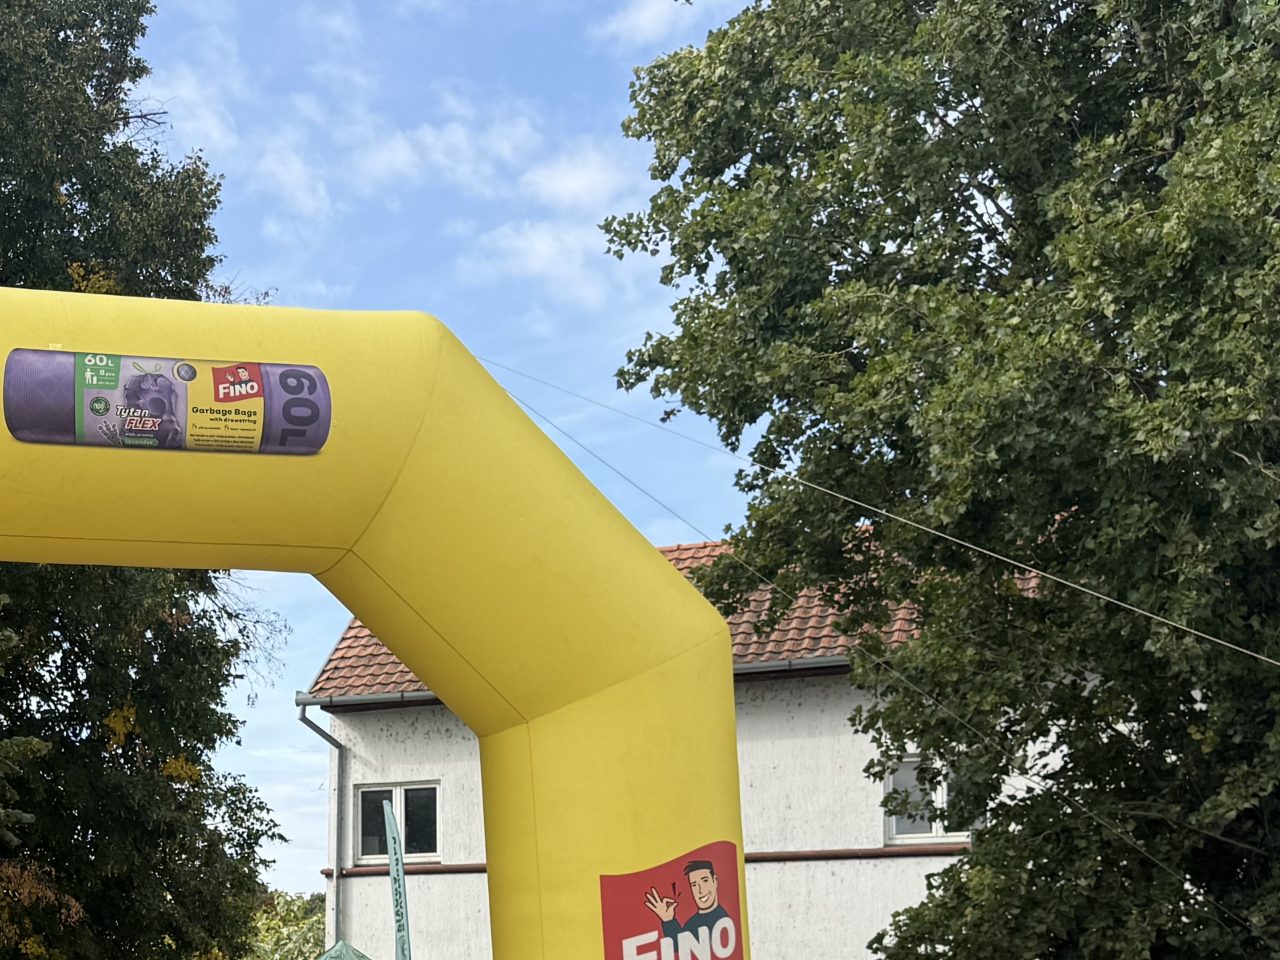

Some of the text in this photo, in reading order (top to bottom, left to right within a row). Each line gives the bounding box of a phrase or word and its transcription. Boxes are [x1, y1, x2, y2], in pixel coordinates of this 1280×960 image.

[218, 381, 259, 399] FINO
[116, 405, 149, 418] Tytan
[191, 406, 258, 417] Garbage Bags
[279, 368, 320, 447] 60L
[124, 416, 162, 430] FLEX
